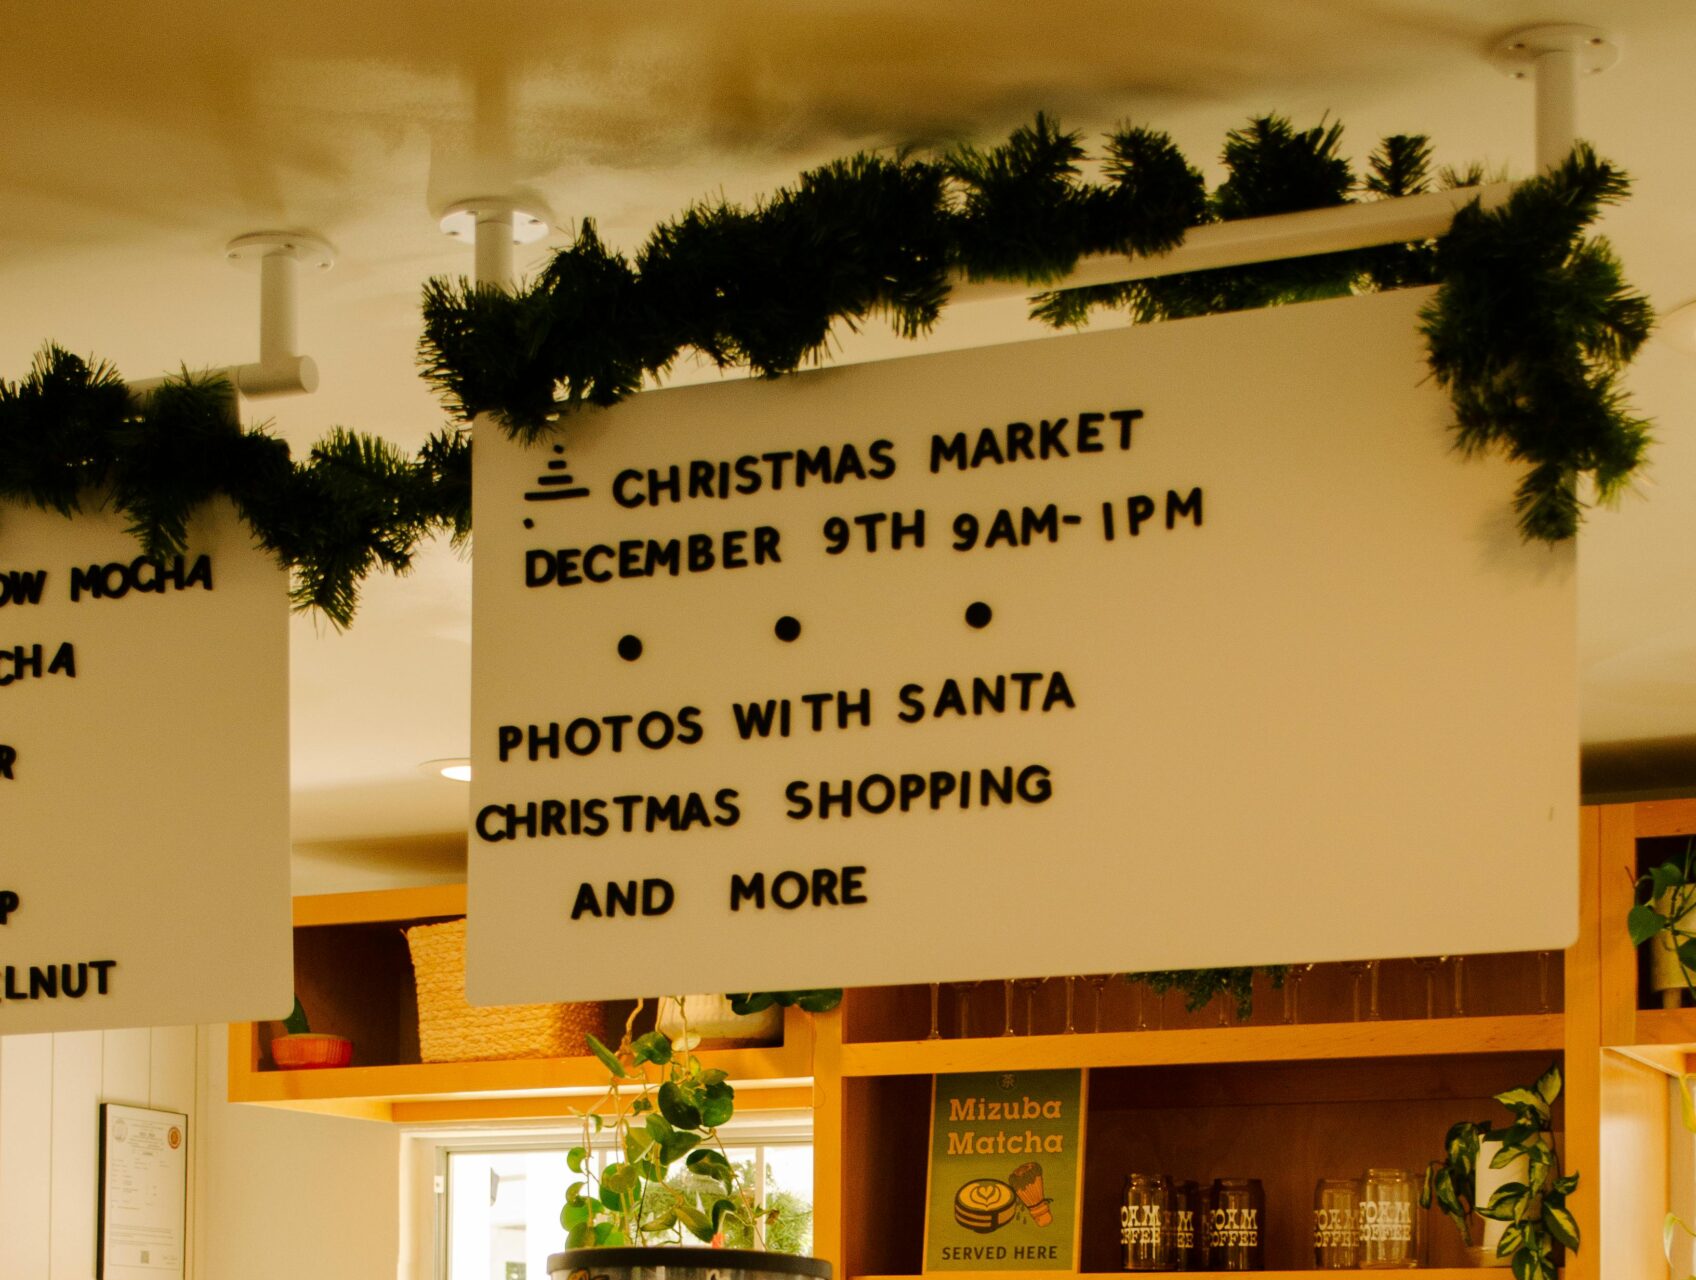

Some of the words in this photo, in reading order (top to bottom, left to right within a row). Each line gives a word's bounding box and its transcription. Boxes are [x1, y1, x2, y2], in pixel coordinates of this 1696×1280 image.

[611, 438, 897, 510] CHRISTMAS
[929, 409, 1144, 474] MARKET
[525, 525, 782, 589] DECEMBER
[823, 508, 925, 555] 9TH
[0, 570, 48, 608] W
[70, 556, 214, 602] MOCHA
[498, 705, 704, 763] PHOTOS
[732, 688, 871, 740] WITH
[897, 671, 1076, 724] SANTA
[475, 788, 741, 843] CHRISTMAS
[785, 764, 1052, 820] SHOPPING
[570, 878, 675, 921] AND
[730, 865, 868, 912] MORE
[0, 959, 117, 1000] LNUT
[949, 1096, 1062, 1121] Mizuba
[947, 1130, 1063, 1155] Matcha
[1121, 1205, 1161, 1228] OAM
[941, 1246, 1007, 1260] SERVED
[1014, 1245, 1058, 1259] HERE
